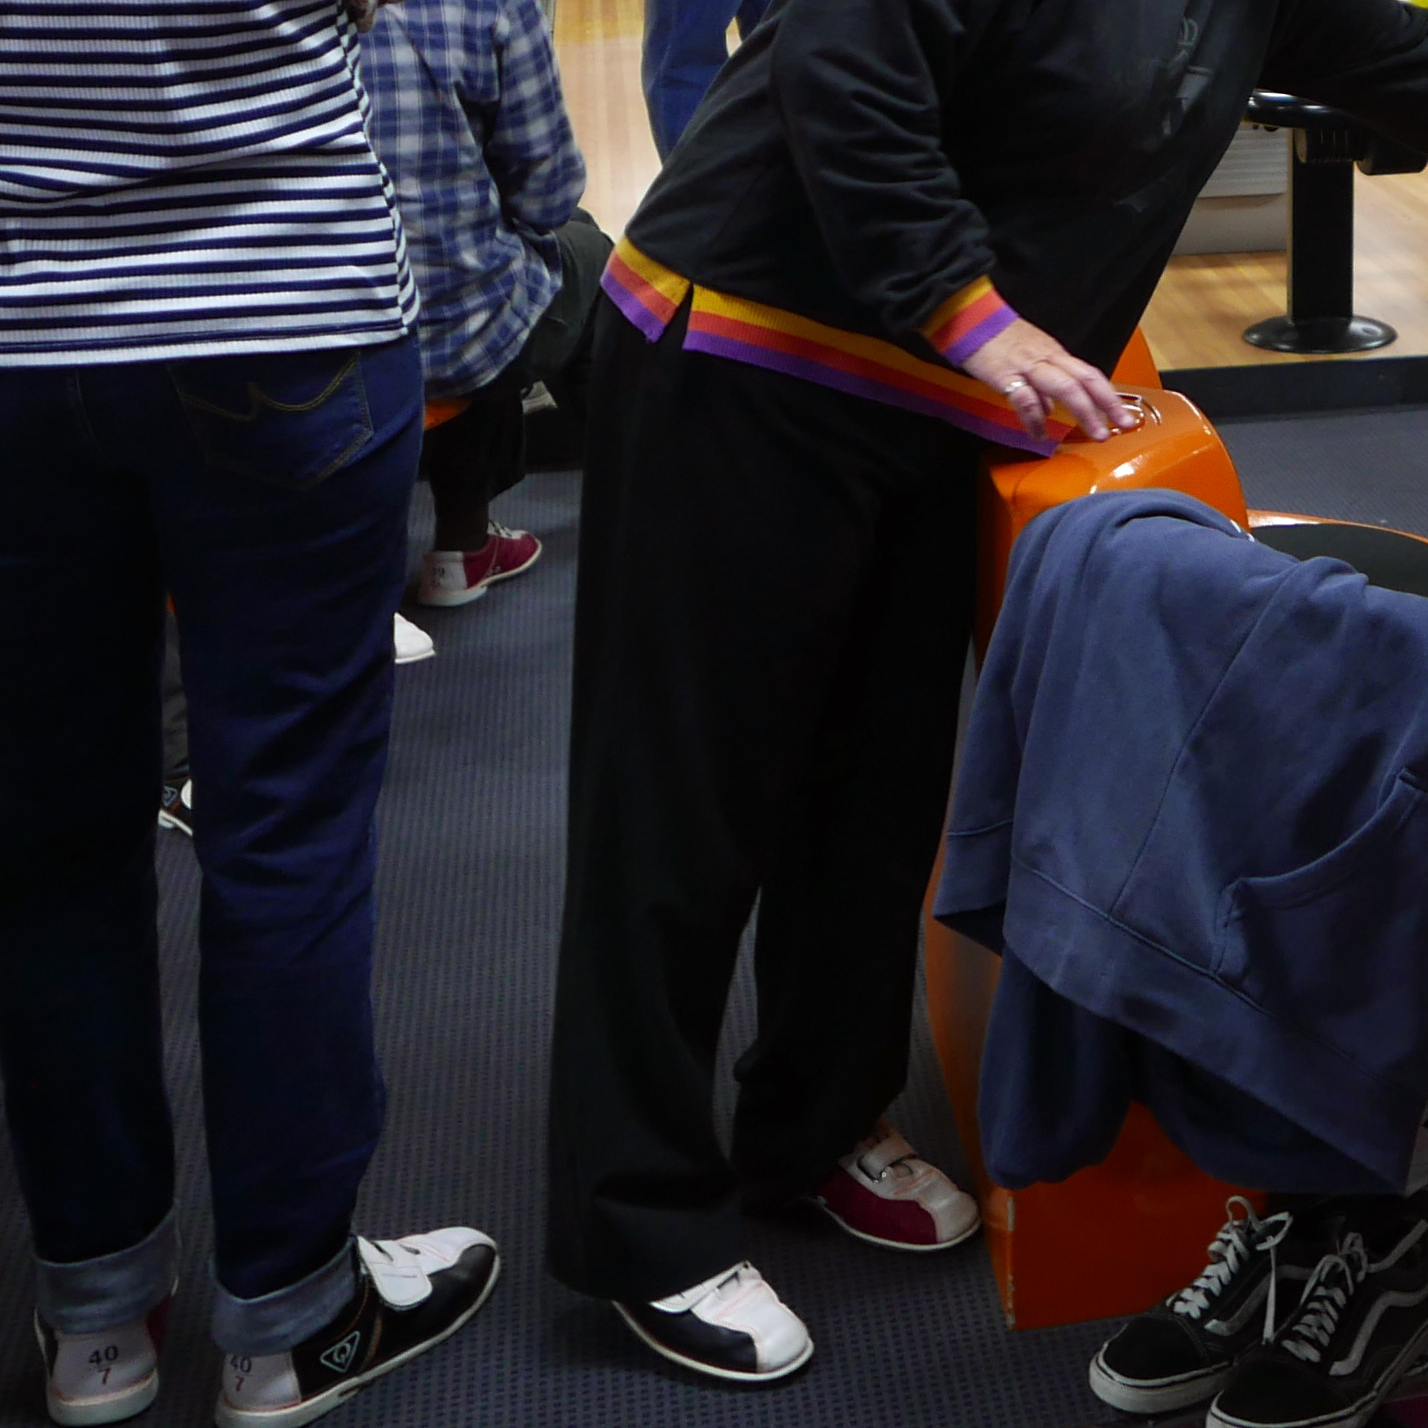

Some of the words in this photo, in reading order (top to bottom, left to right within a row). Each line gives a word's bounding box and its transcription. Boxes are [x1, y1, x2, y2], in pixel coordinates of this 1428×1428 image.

[88, 1344, 119, 1366] 40
[99, 1367, 111, 1385] 7
[234, 1375, 244, 1392] 7
